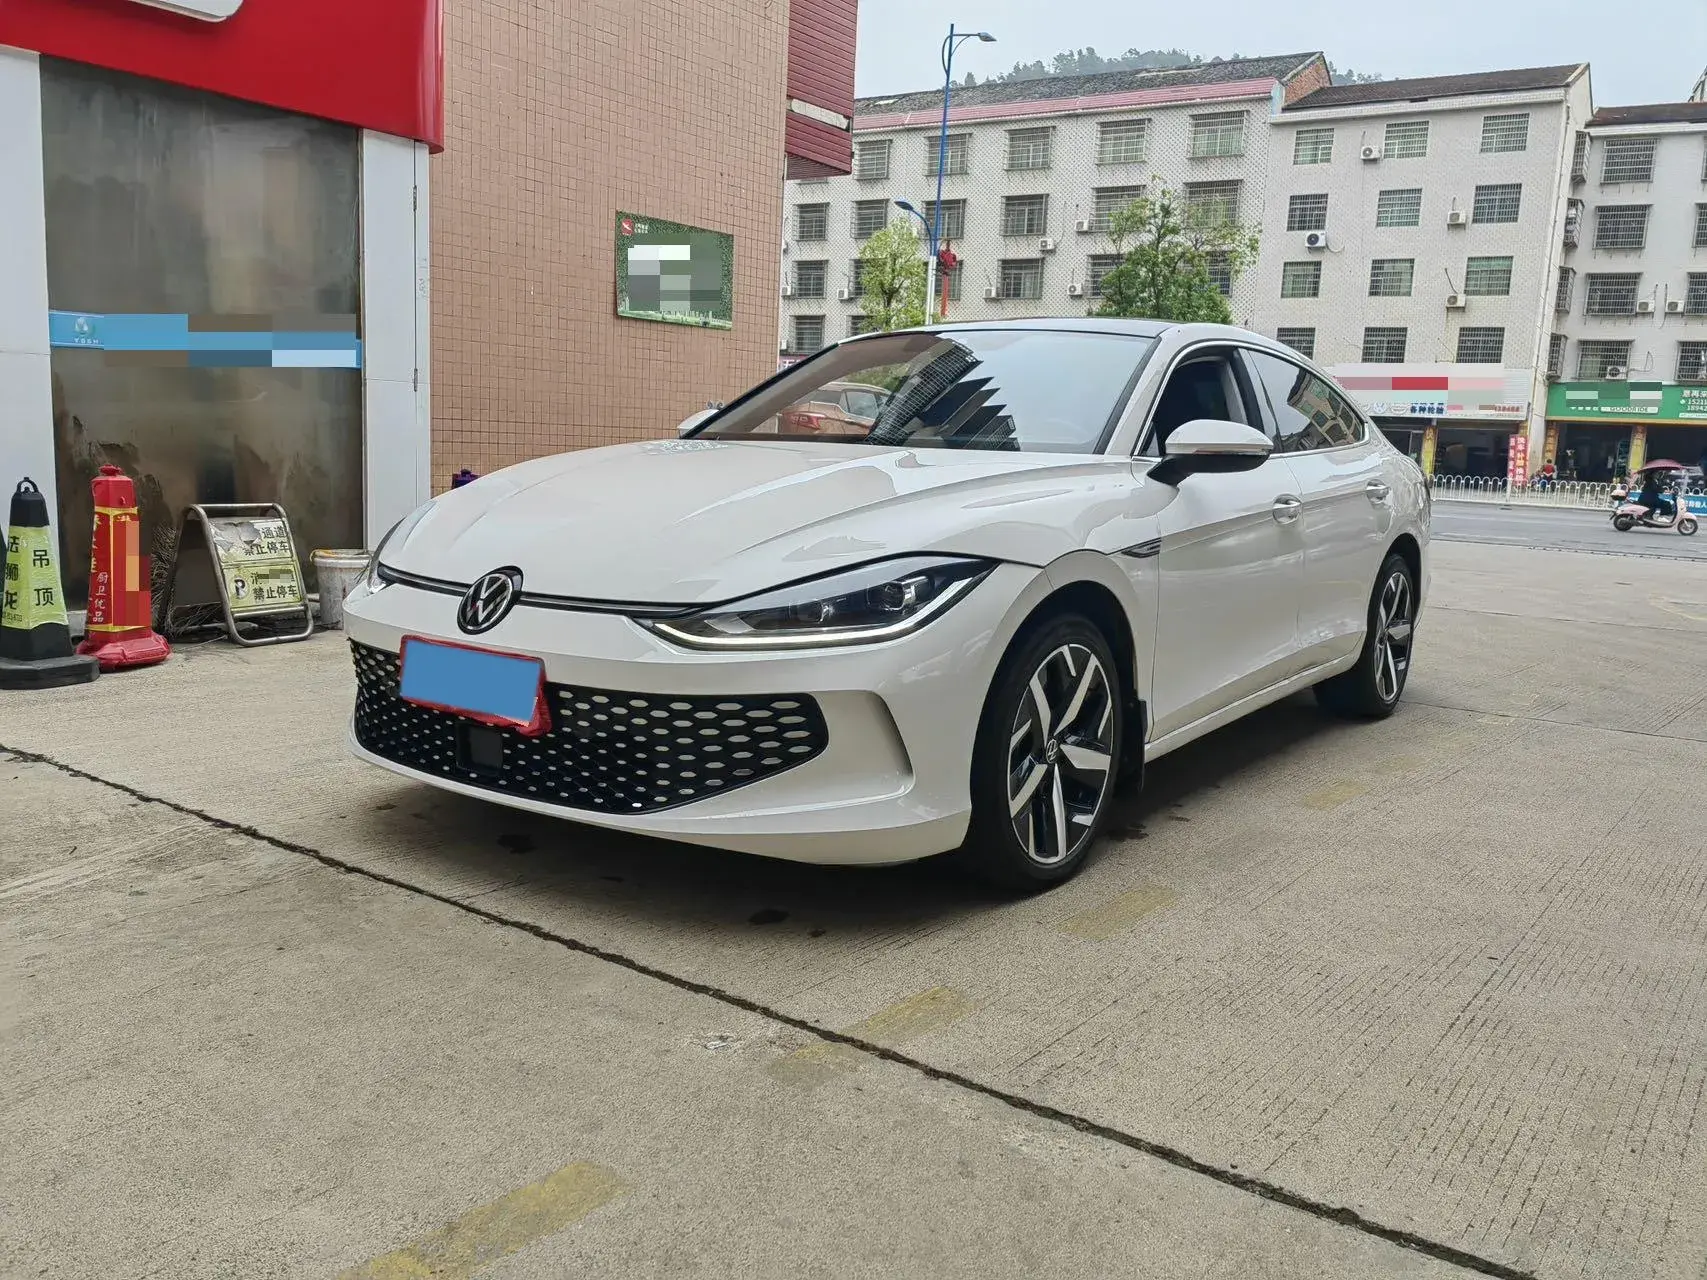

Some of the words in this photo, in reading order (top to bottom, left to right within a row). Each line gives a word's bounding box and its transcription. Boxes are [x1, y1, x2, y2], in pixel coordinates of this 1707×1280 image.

[260, 526, 288, 539] 通道
[243, 540, 290, 556] 禁止停车
[32, 549, 55, 607] 吊顶
[252, 585, 298, 601] 禁止停车
